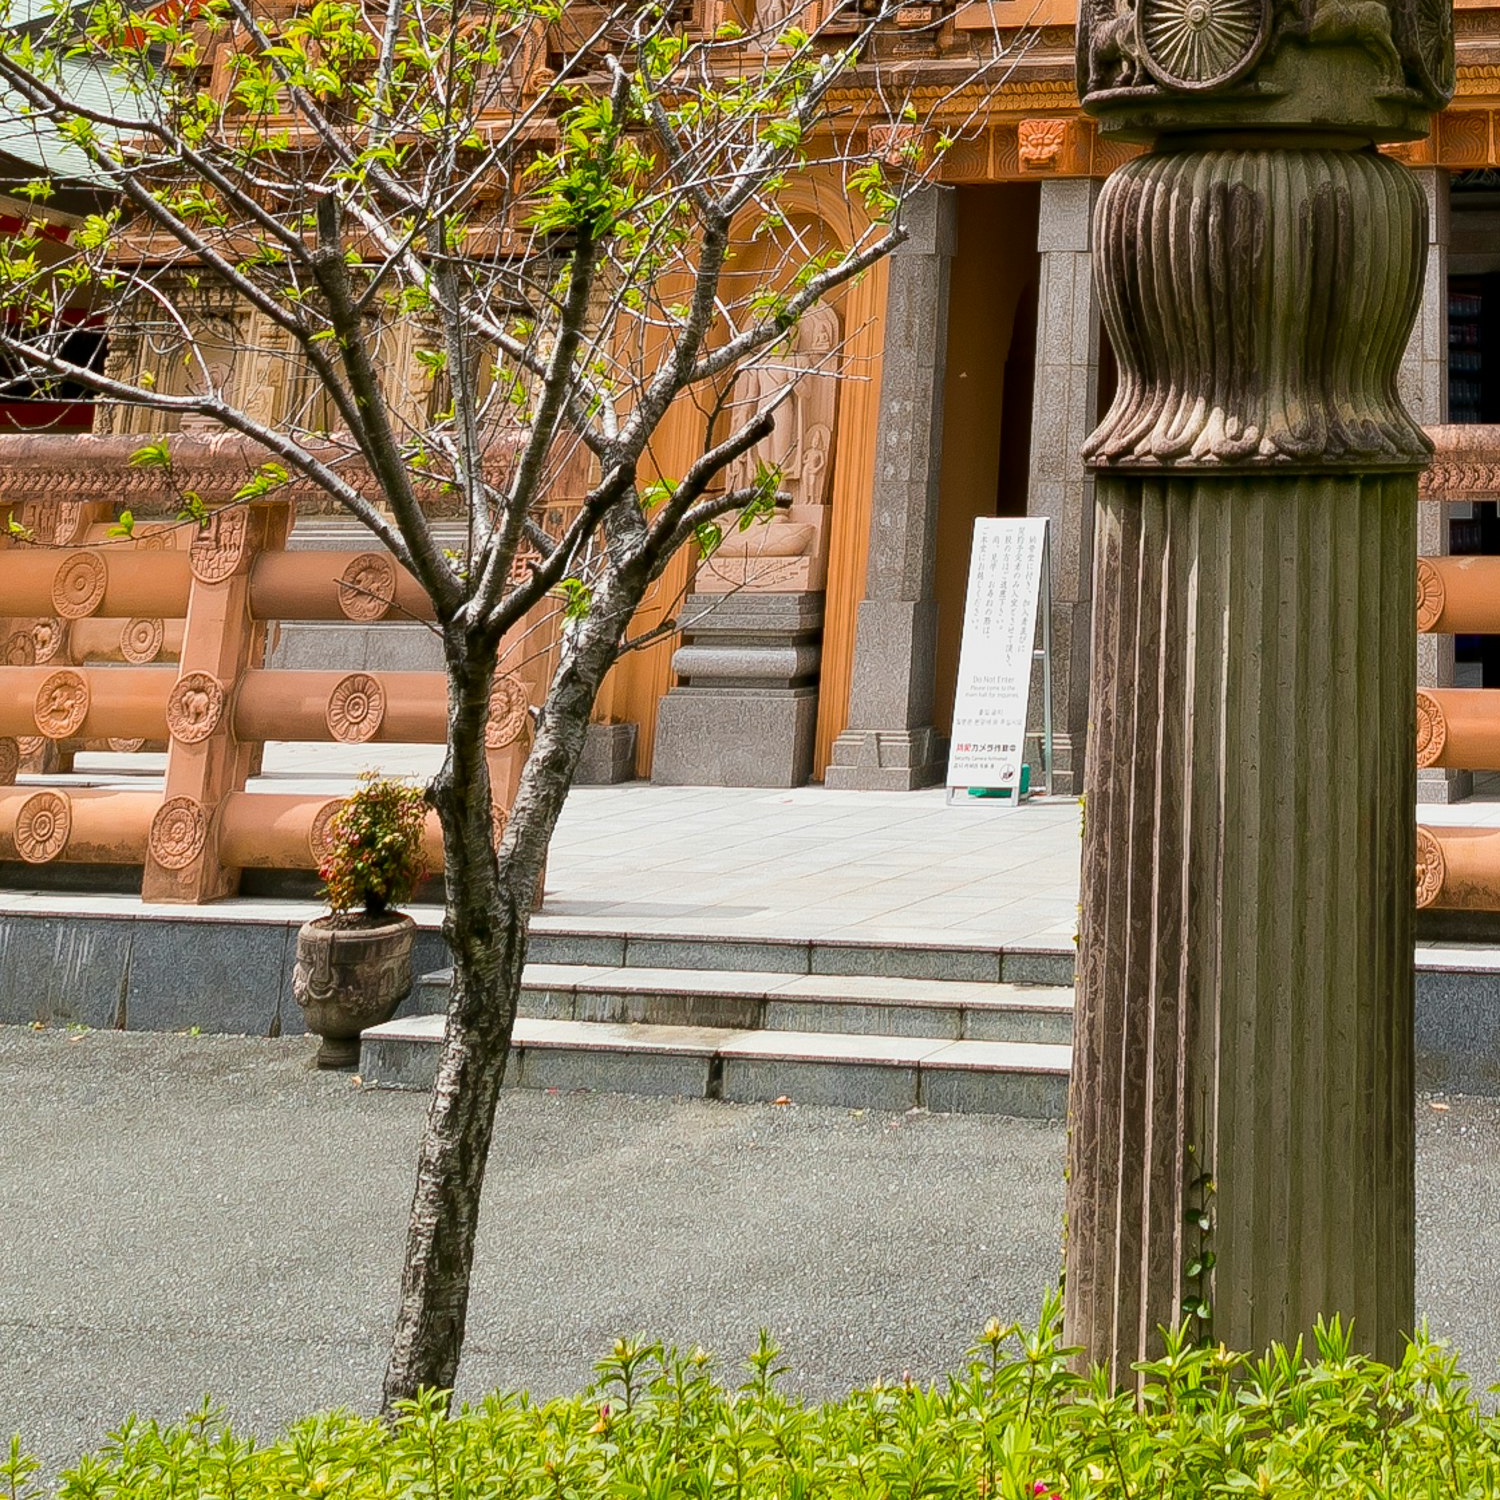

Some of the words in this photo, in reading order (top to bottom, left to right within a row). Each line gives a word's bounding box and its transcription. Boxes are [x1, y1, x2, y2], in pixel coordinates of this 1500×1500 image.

[973, 675, 982, 683] Do
[984, 675, 995, 683] Not
[997, 675, 1014, 683] Enter
